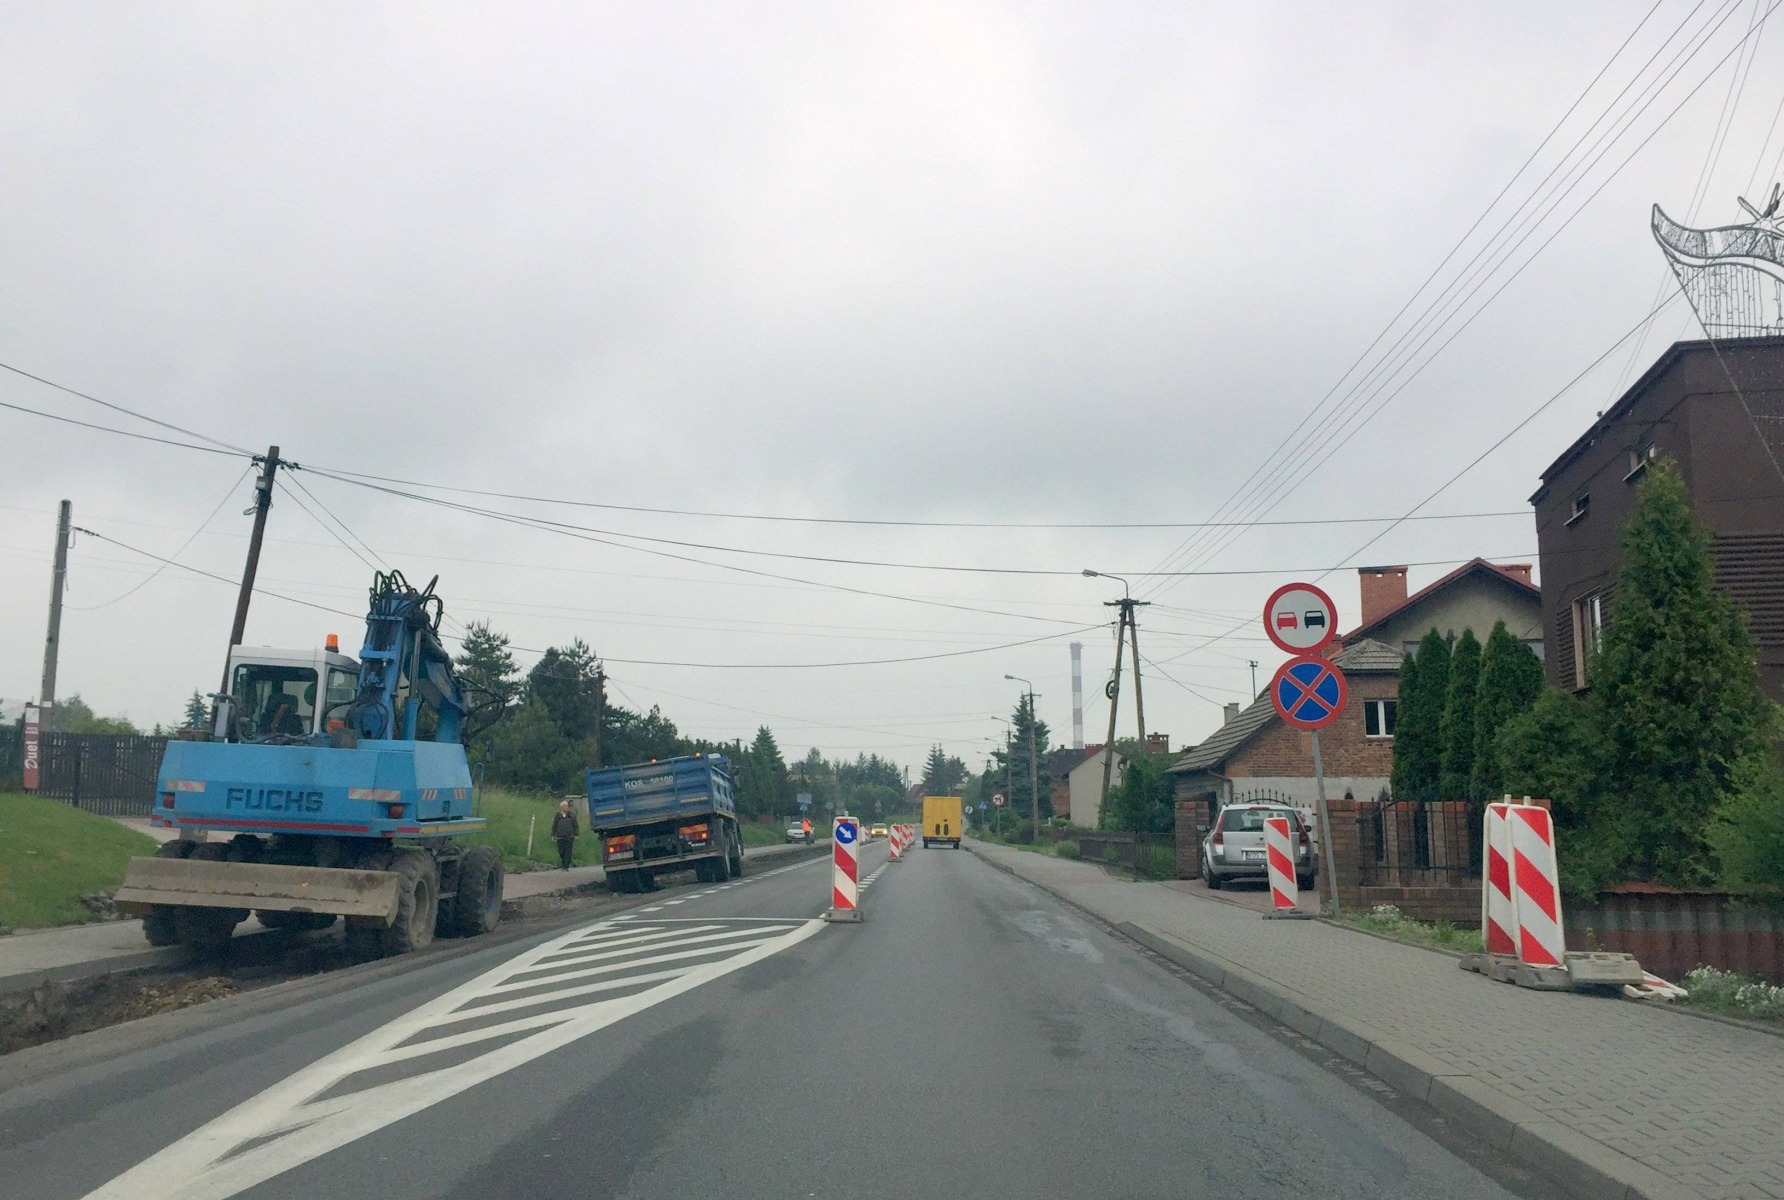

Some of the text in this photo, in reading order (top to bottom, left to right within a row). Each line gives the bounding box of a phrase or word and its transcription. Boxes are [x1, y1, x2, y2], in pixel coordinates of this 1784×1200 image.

[24, 740, 38, 769] Duet
[624, 779, 644, 789] KOS
[226, 787, 323, 813] FUCHS
